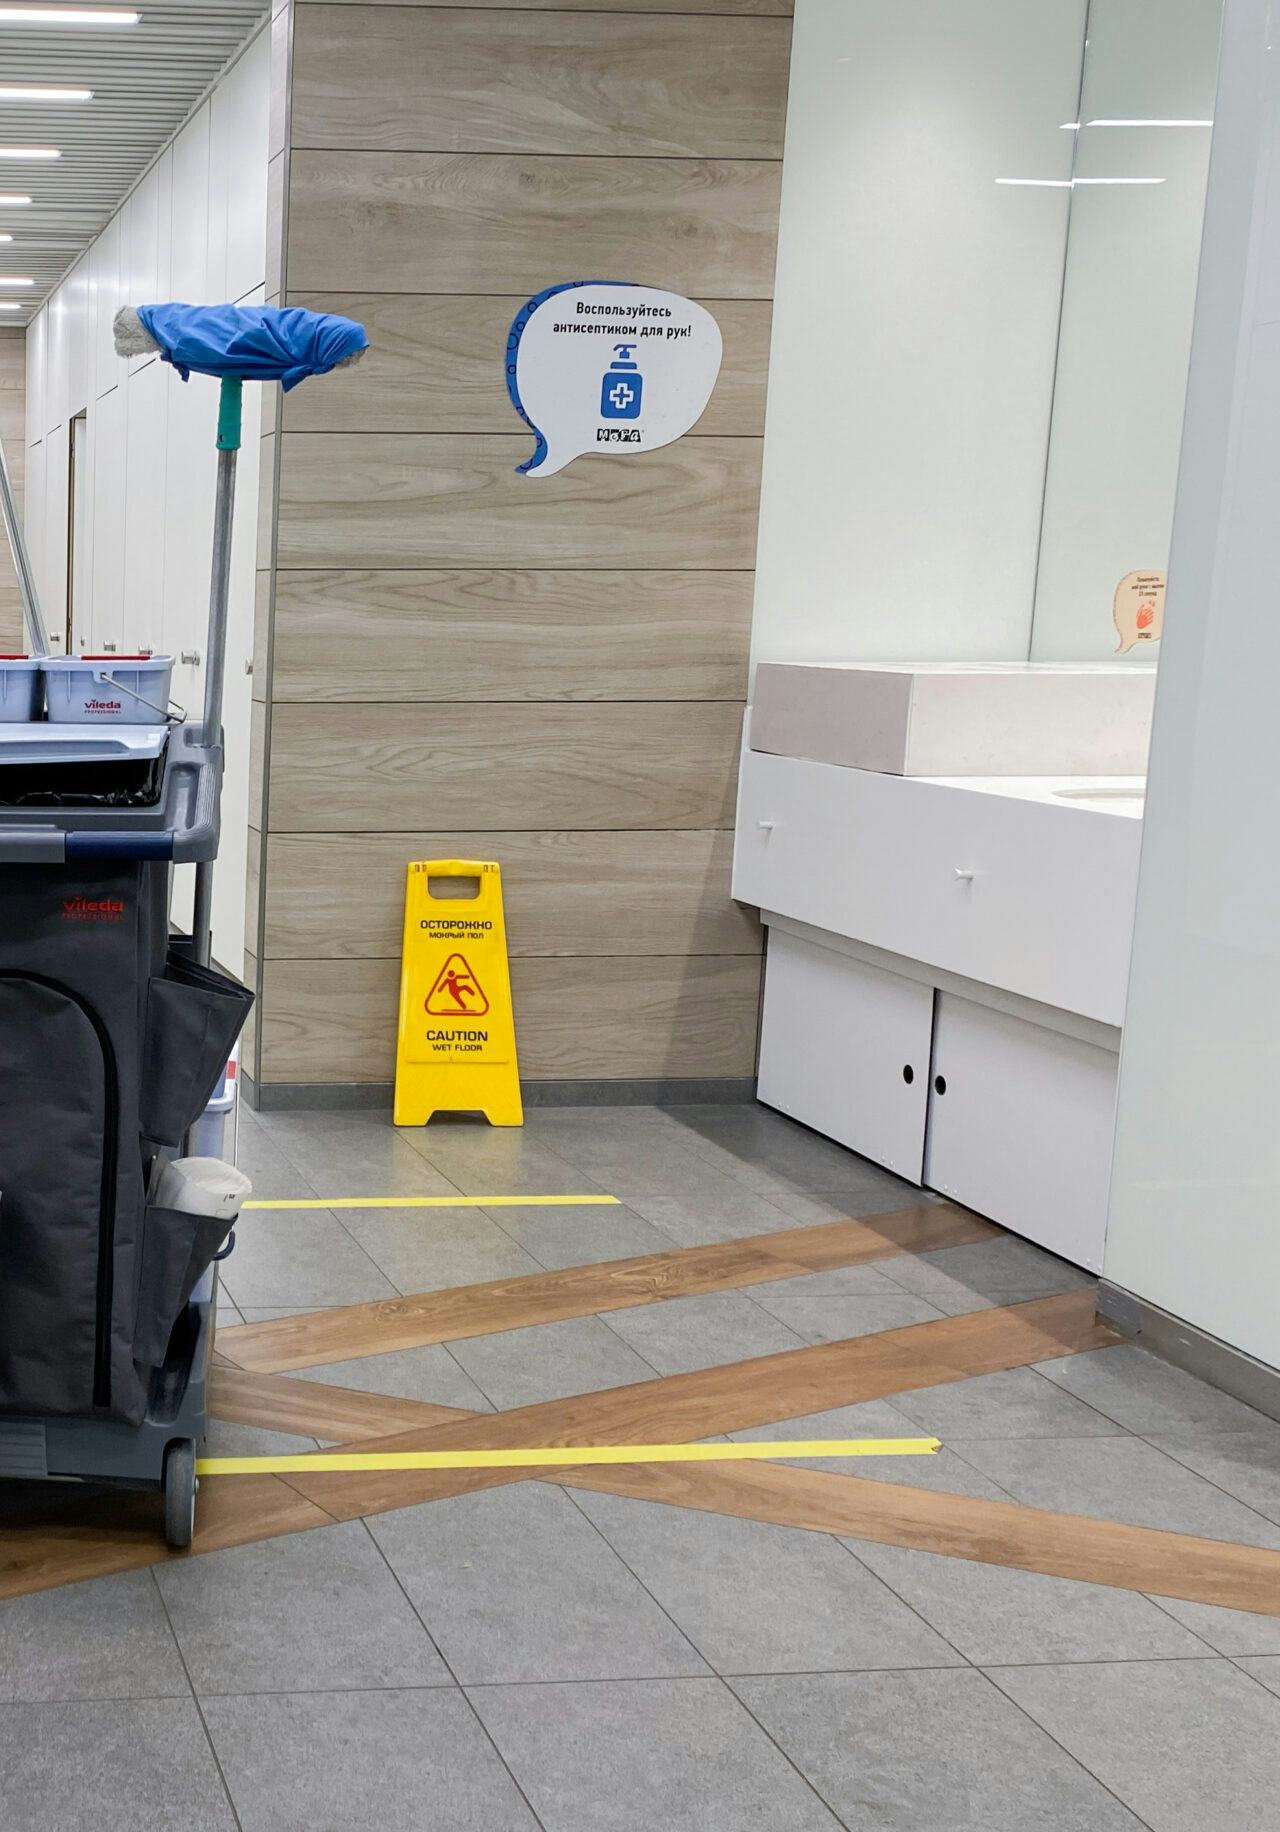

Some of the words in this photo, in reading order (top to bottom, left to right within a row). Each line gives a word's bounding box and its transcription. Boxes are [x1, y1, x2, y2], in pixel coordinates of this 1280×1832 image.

[576, 302, 672, 319] Воспользуйтесь
[553, 322, 637, 336] антисептиком
[640, 325, 663, 338] для
[666, 325, 692, 340] рук!
[84, 699, 121, 709] vileda
[63, 896, 124, 912] vileda
[420, 920, 492, 930] ОСТОРОЖНО
[426, 1030, 488, 1042] CAUTION
